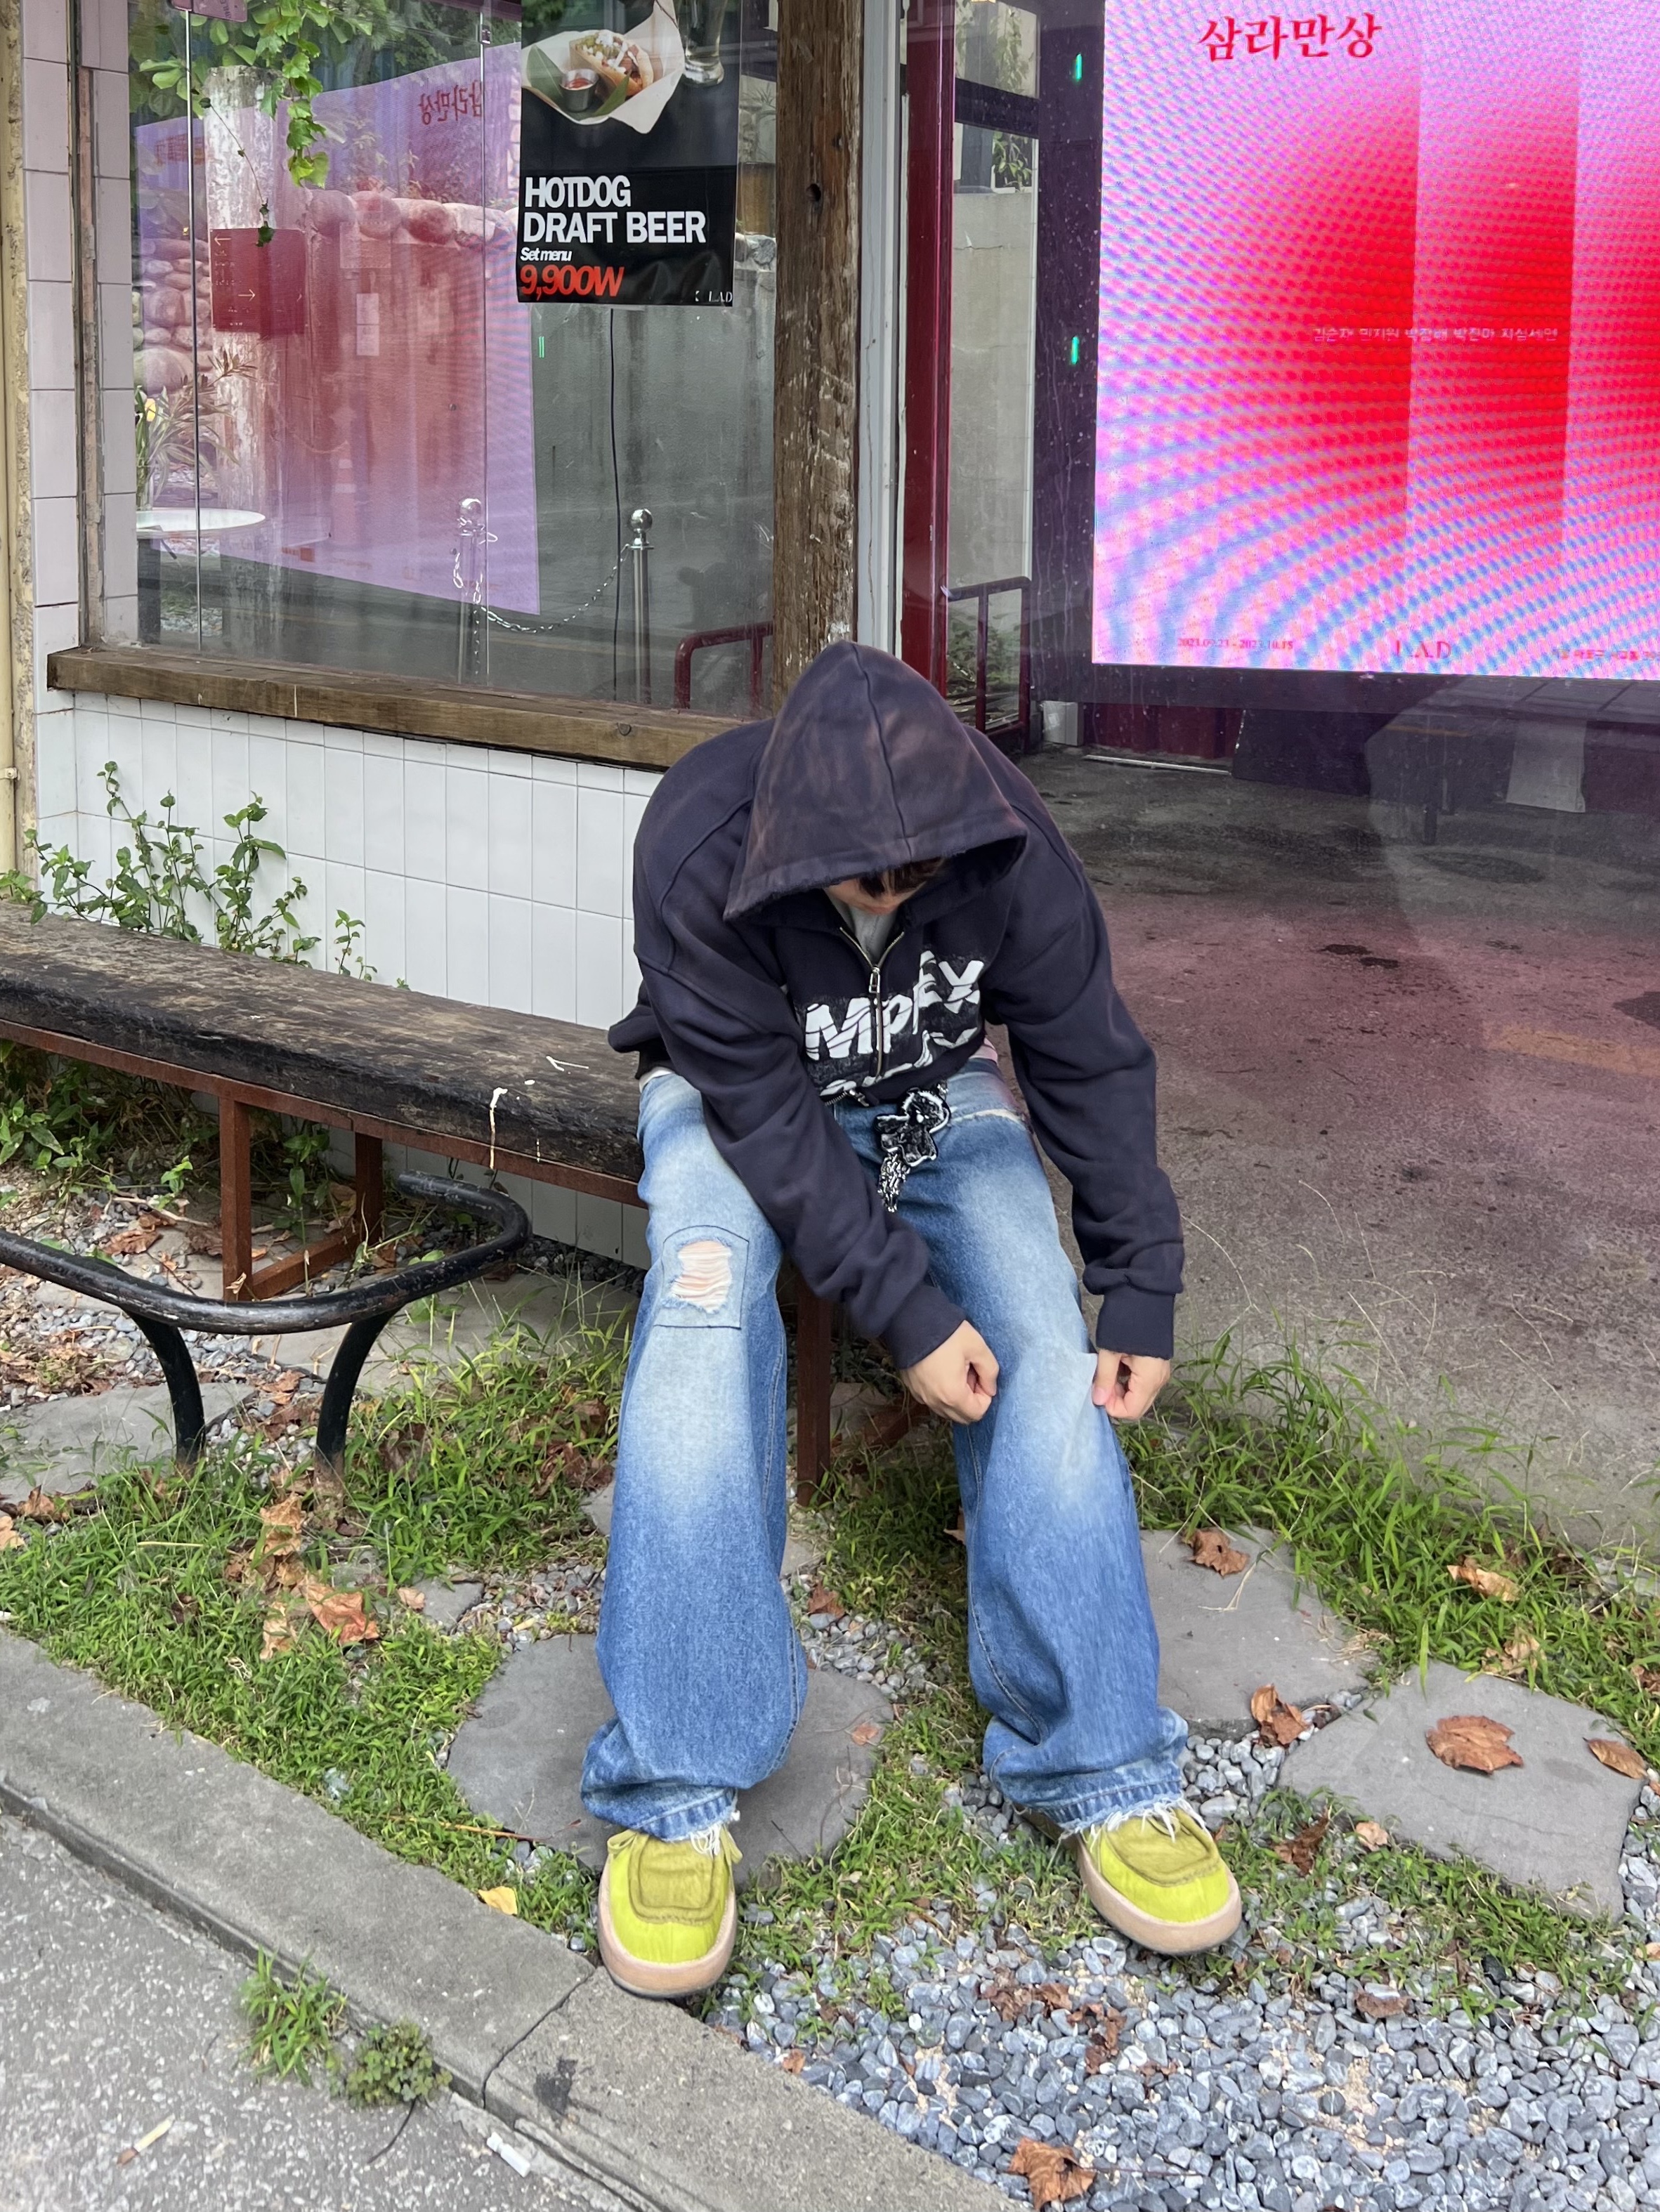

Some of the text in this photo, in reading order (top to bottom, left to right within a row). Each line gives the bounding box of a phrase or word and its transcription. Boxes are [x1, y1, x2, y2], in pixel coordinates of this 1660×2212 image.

[1198, 12, 1383, 62] 삼라만상
[524, 175, 632, 208] HOTDOG
[523, 211, 706, 244] DRAFT BEER
[520, 247, 573, 261] Set menu
[520, 264, 625, 301] 9,900W
